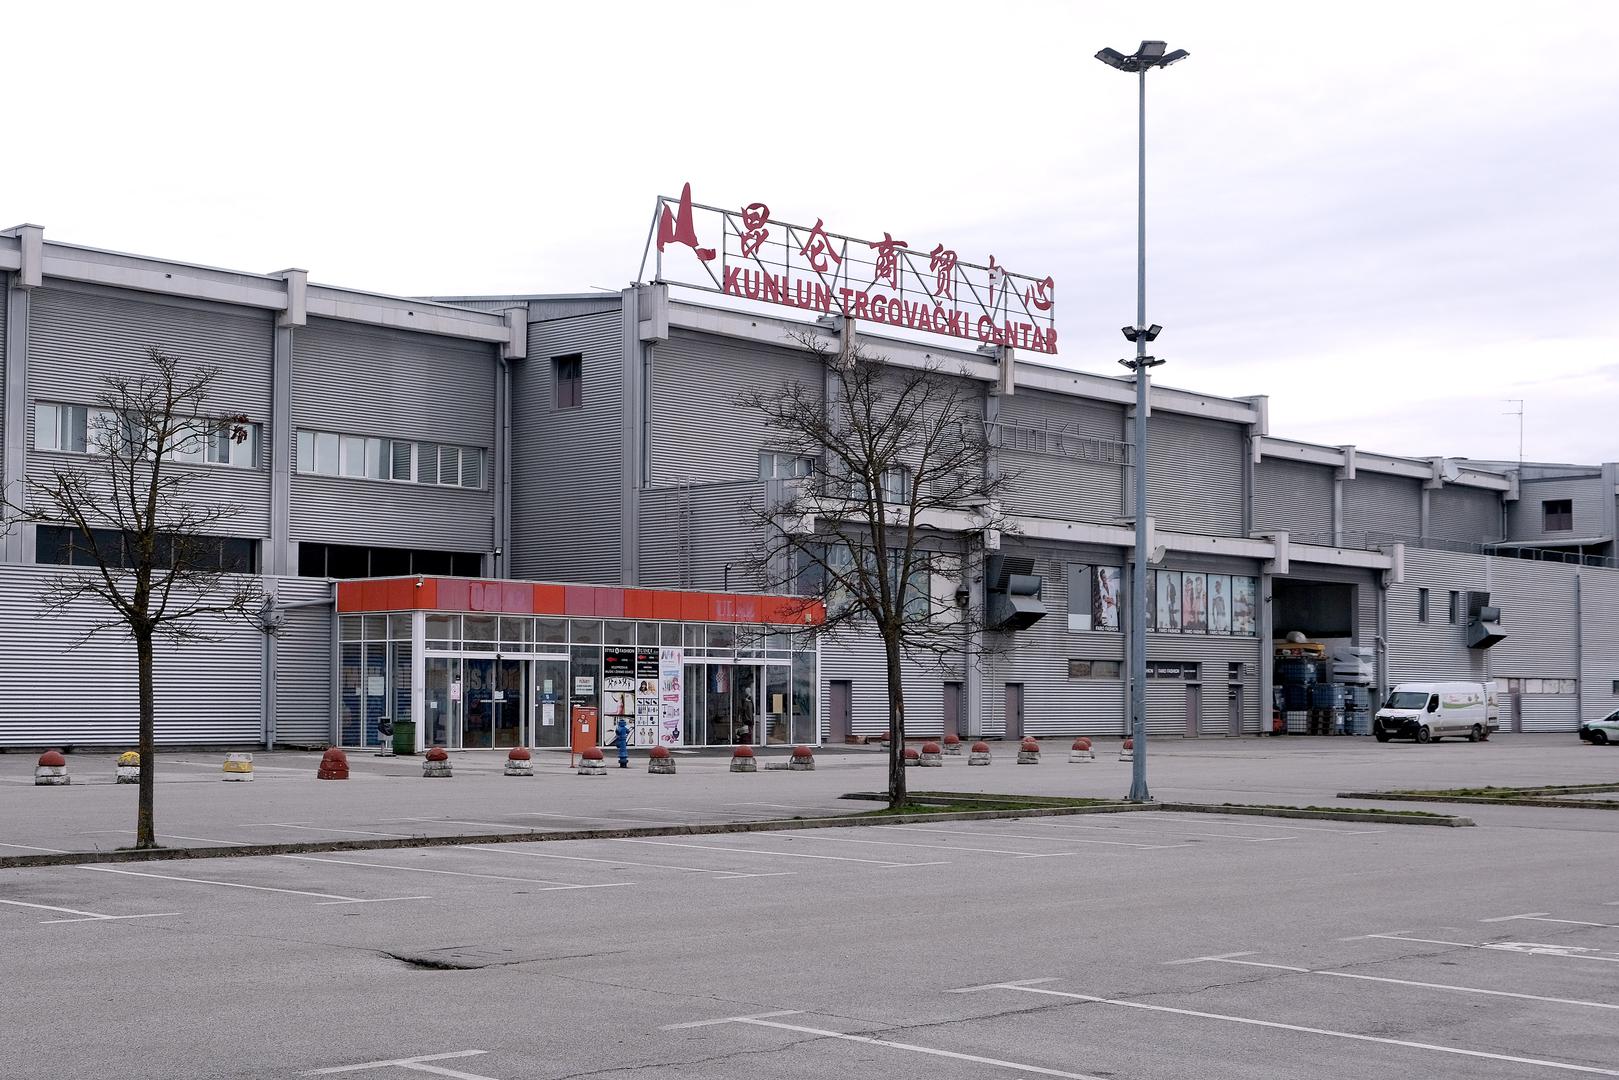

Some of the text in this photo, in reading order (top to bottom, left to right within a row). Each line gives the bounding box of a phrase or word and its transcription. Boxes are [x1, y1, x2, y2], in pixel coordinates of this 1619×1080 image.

[724, 265, 1058, 354] KUNLUN TRGOVAČKI CENTAR
